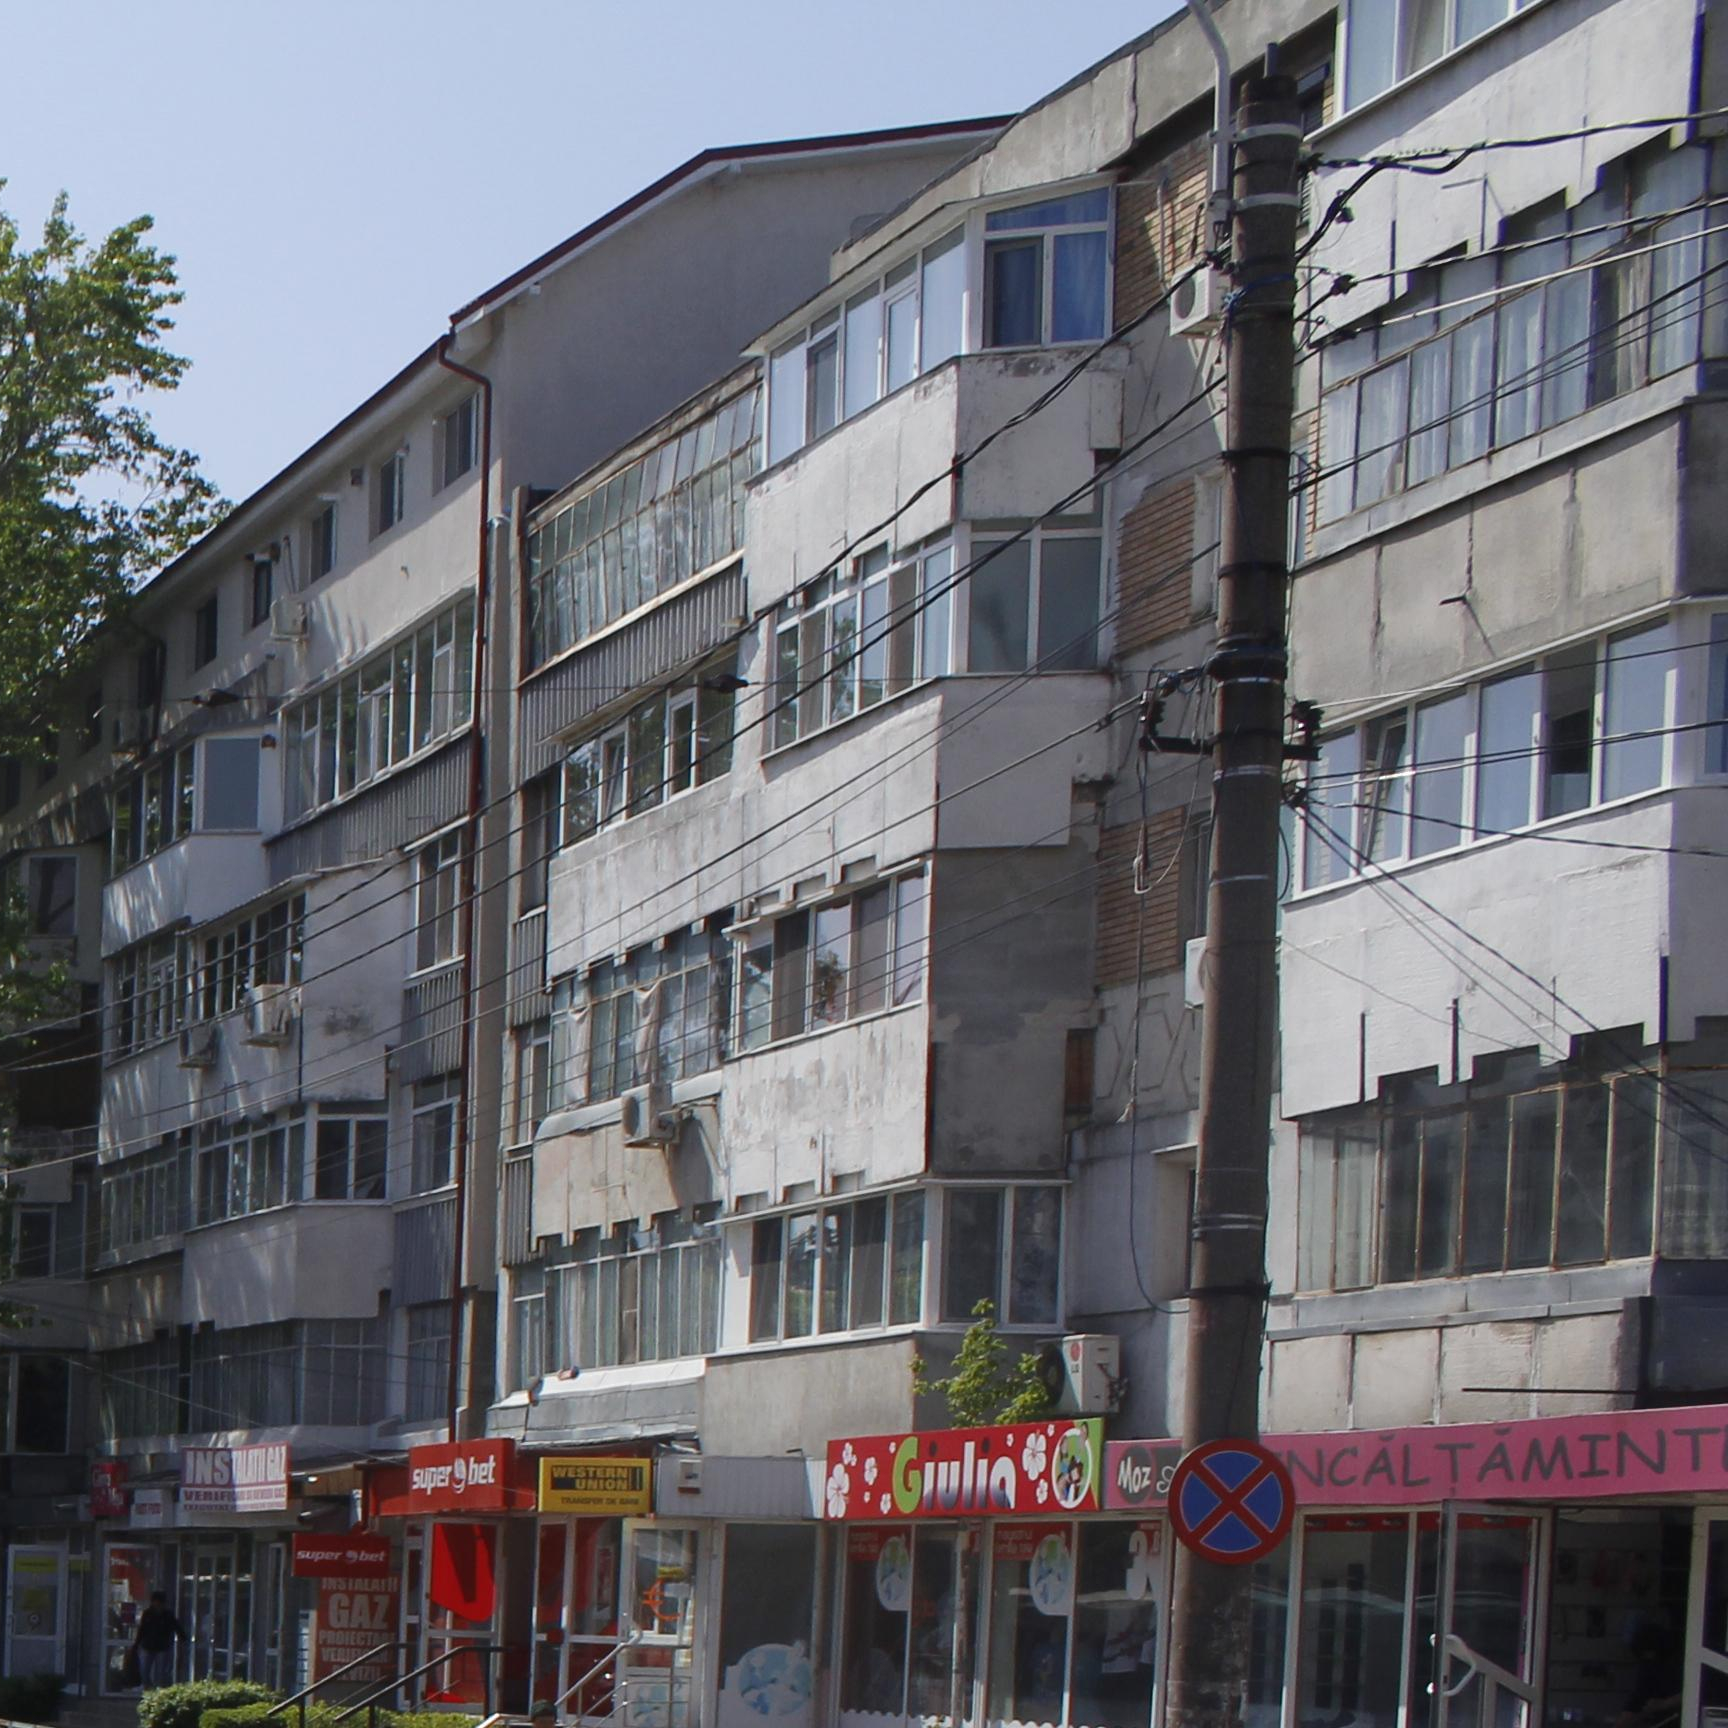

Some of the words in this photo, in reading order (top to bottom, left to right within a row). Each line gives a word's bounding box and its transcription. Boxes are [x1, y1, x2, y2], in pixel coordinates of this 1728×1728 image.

[412, 1465, 452, 1495] super
[468, 1455, 496, 1485] bet
[552, 1467, 628, 1478] WESTERN
[894, 1436, 1016, 1514] Giulia
[1118, 1456, 1152, 1494] Moz
[1274, 1426, 1728, 1497] NCĂLȚĂMINT
[575, 1479, 628, 1490] UNION
[296, 1550, 343, 1562] super
[358, 1550, 387, 1562] bet
[328, 1593, 390, 1630] GAZ
